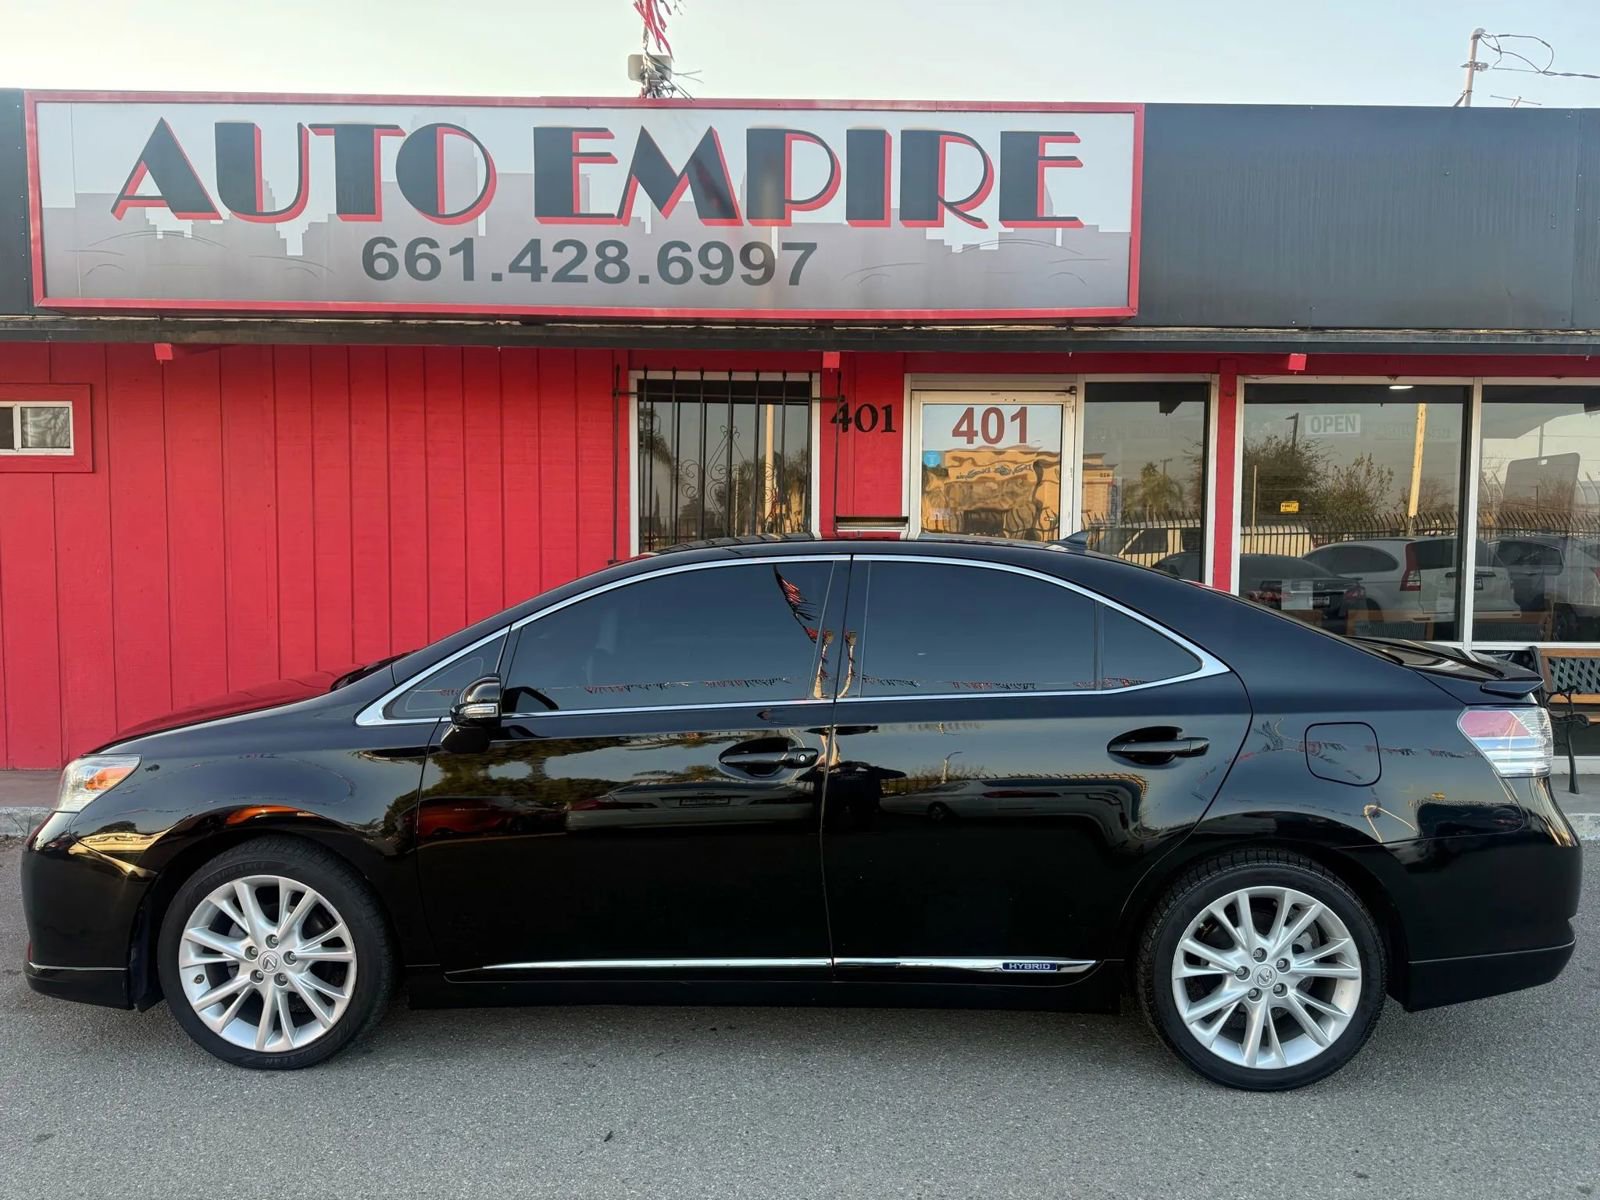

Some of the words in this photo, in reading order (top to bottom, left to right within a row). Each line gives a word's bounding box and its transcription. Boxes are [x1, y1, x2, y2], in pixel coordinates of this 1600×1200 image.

[110, 117, 497, 224] AUTO
[533, 125, 1084, 229] EMPIRE
[363, 237, 818, 286] 661.428.6997
[831, 403, 897, 433] 401
[952, 407, 1028, 444] 401
[1310, 415, 1356, 433] OPEN
